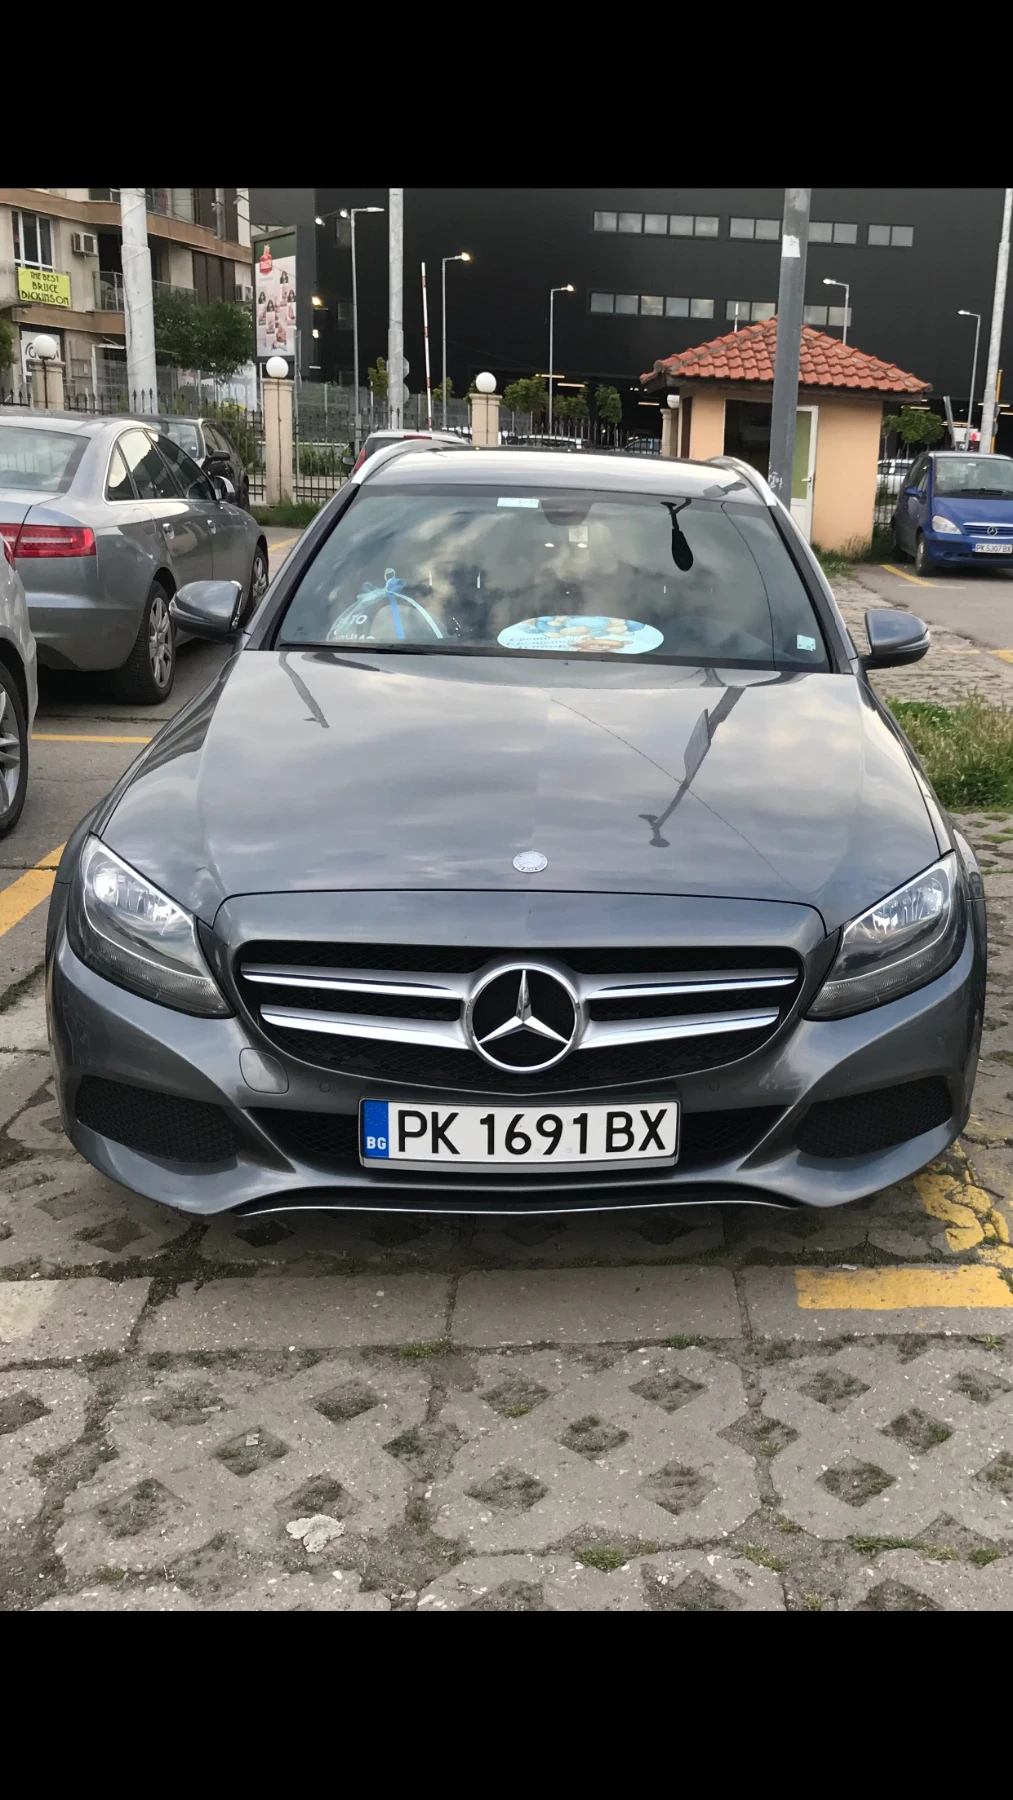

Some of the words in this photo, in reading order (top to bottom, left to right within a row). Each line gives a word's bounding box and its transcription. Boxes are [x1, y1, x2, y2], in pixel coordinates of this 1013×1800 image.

[30, 271, 41, 280] THE
[42, 273, 59, 282] BEST
[32, 281, 59, 293] BRUCE
[21, 290, 70, 305] DICKINSON
[398, 1110, 460, 1155] PK
[480, 1113, 588, 1156] 1691
[605, 1109, 668, 1153] BX
[366, 1136, 387, 1150] BG
